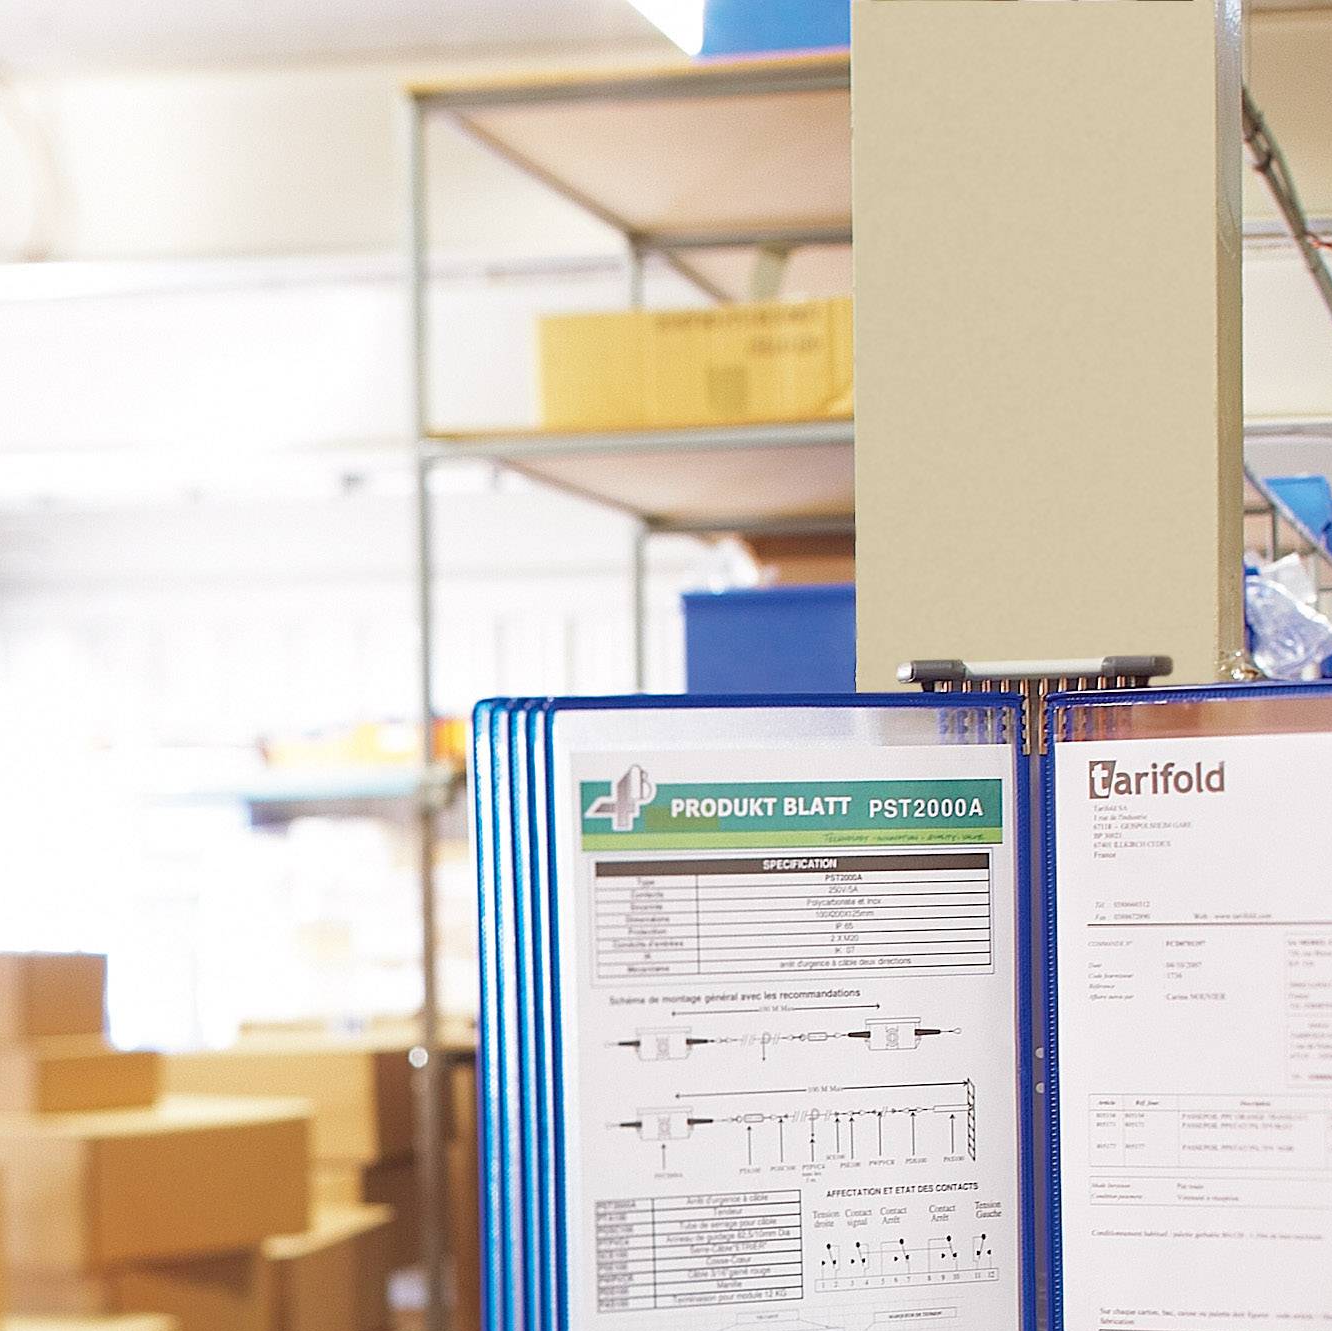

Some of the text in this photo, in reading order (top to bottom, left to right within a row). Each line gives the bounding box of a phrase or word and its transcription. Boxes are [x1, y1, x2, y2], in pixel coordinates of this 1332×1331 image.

[1089, 760, 1225, 799] tarifold
[670, 795, 985, 820] PRODUKT BLATT PST2000A
[762, 858, 838, 872] SPECIFICATION
[878, 957, 912, 965] directions
[661, 993, 702, 1006] montage
[704, 992, 739, 1005] général
[741, 992, 761, 1002] avec
[764, 990, 777, 1000] les
[779, 988, 862, 1000] recommandations
[826, 1182, 979, 1199] AFFECTATION ET ETAT DES CONTACTS
[928, 1204, 956, 1213] Contact
[974, 1200, 1002, 1210] Tension
[844, 1208, 872, 1217] Contact
[879, 1206, 907, 1216] Contact
[975, 1210, 1003, 1219] Gauche
[974, 1271, 982, 1279] 11
